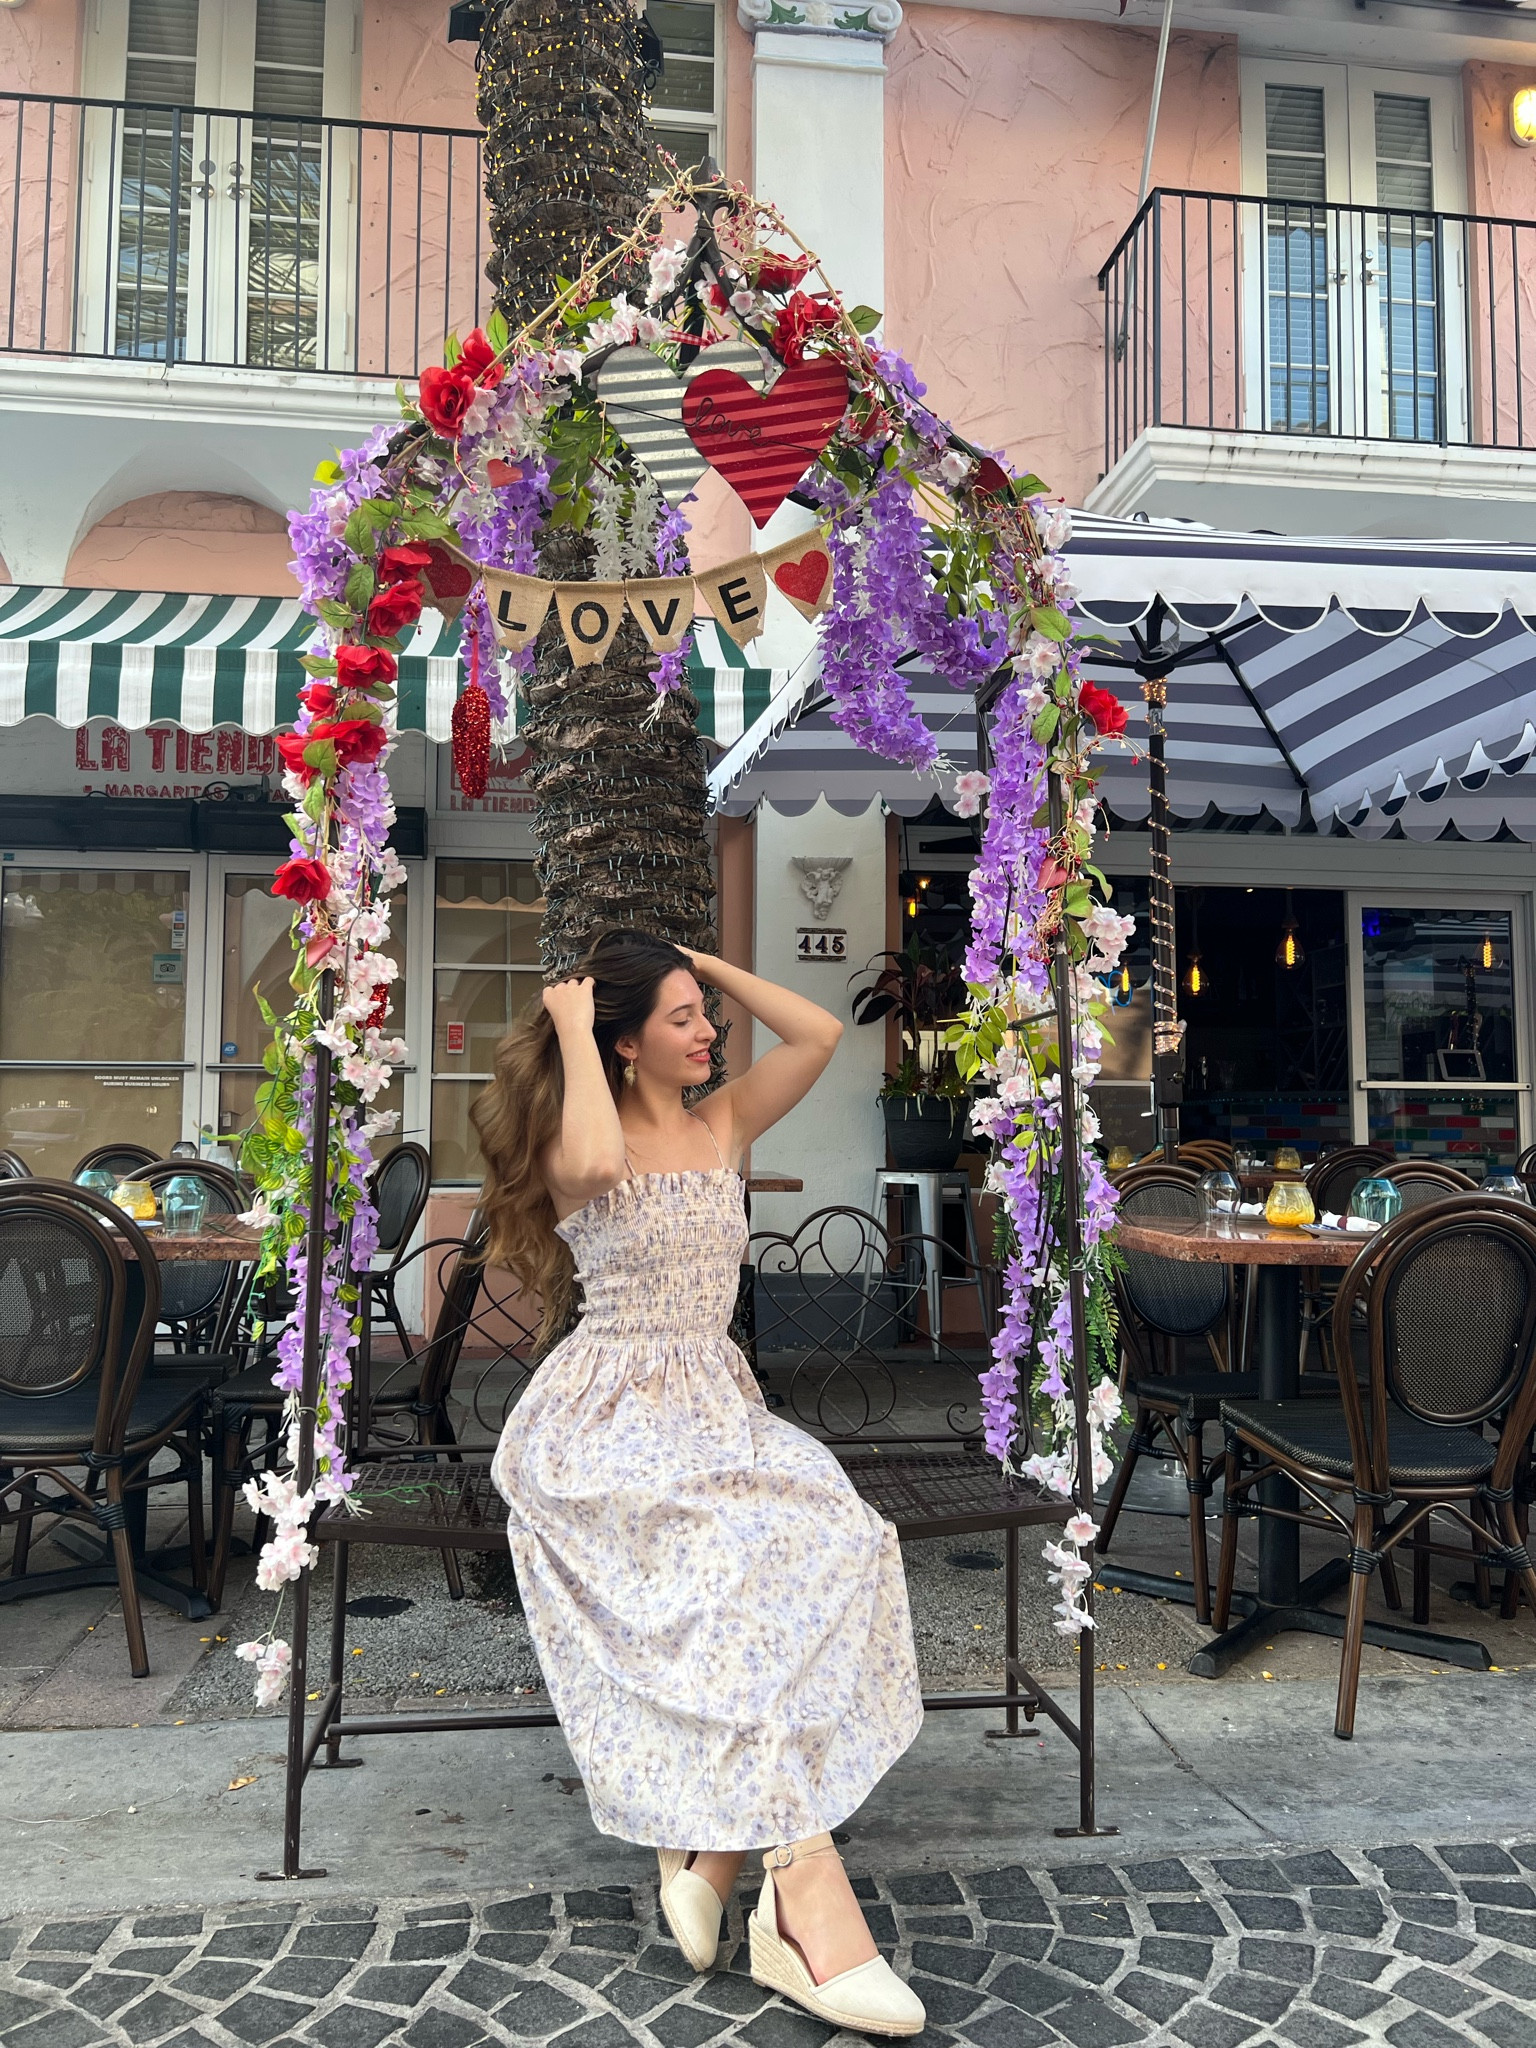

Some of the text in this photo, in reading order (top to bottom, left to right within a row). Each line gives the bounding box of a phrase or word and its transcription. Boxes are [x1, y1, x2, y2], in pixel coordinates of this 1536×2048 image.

[695, 396, 763, 447] love
[497, 576, 760, 645] LOVE
[76, 725, 131, 772] LA
[798, 935, 846, 955] 445
